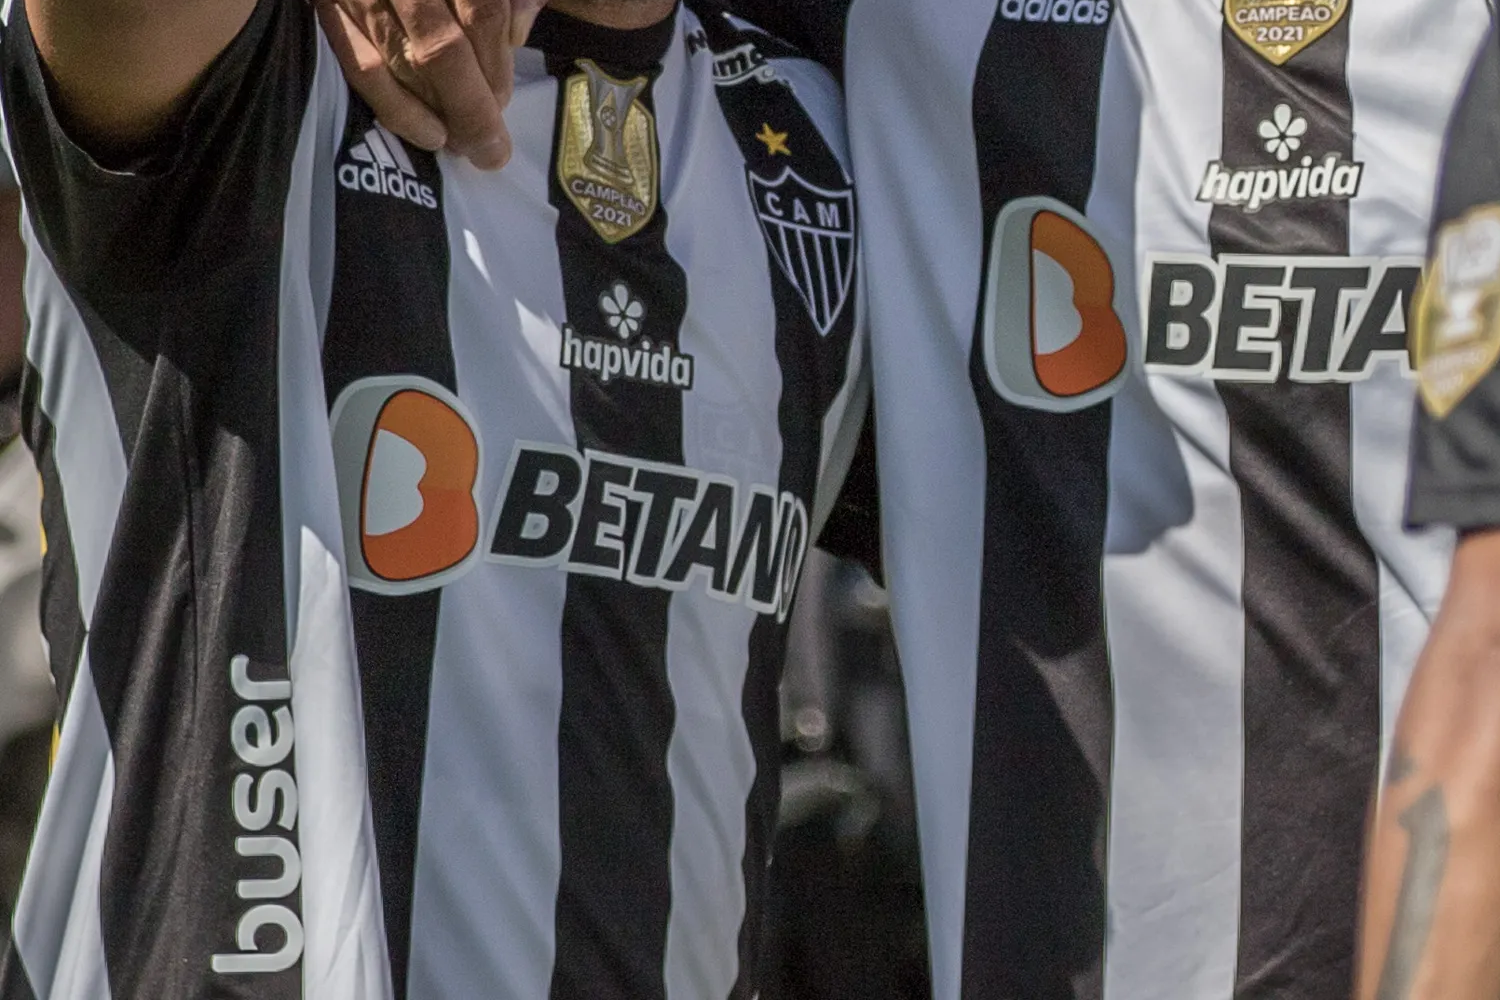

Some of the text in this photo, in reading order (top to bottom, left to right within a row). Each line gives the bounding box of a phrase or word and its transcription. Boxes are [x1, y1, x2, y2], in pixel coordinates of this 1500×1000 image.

[1256, 25, 1304, 41] 2021
[338, 161, 437, 208] adidas
[766, 191, 841, 229] CAM
[1199, 154, 1361, 210] hapvida
[593, 203, 632, 227] 2021
[1144, 256, 1421, 379] BETA
[562, 326, 692, 387] hapvida
[487, 442, 807, 622] BETANO
[211, 654, 304, 973] buser
